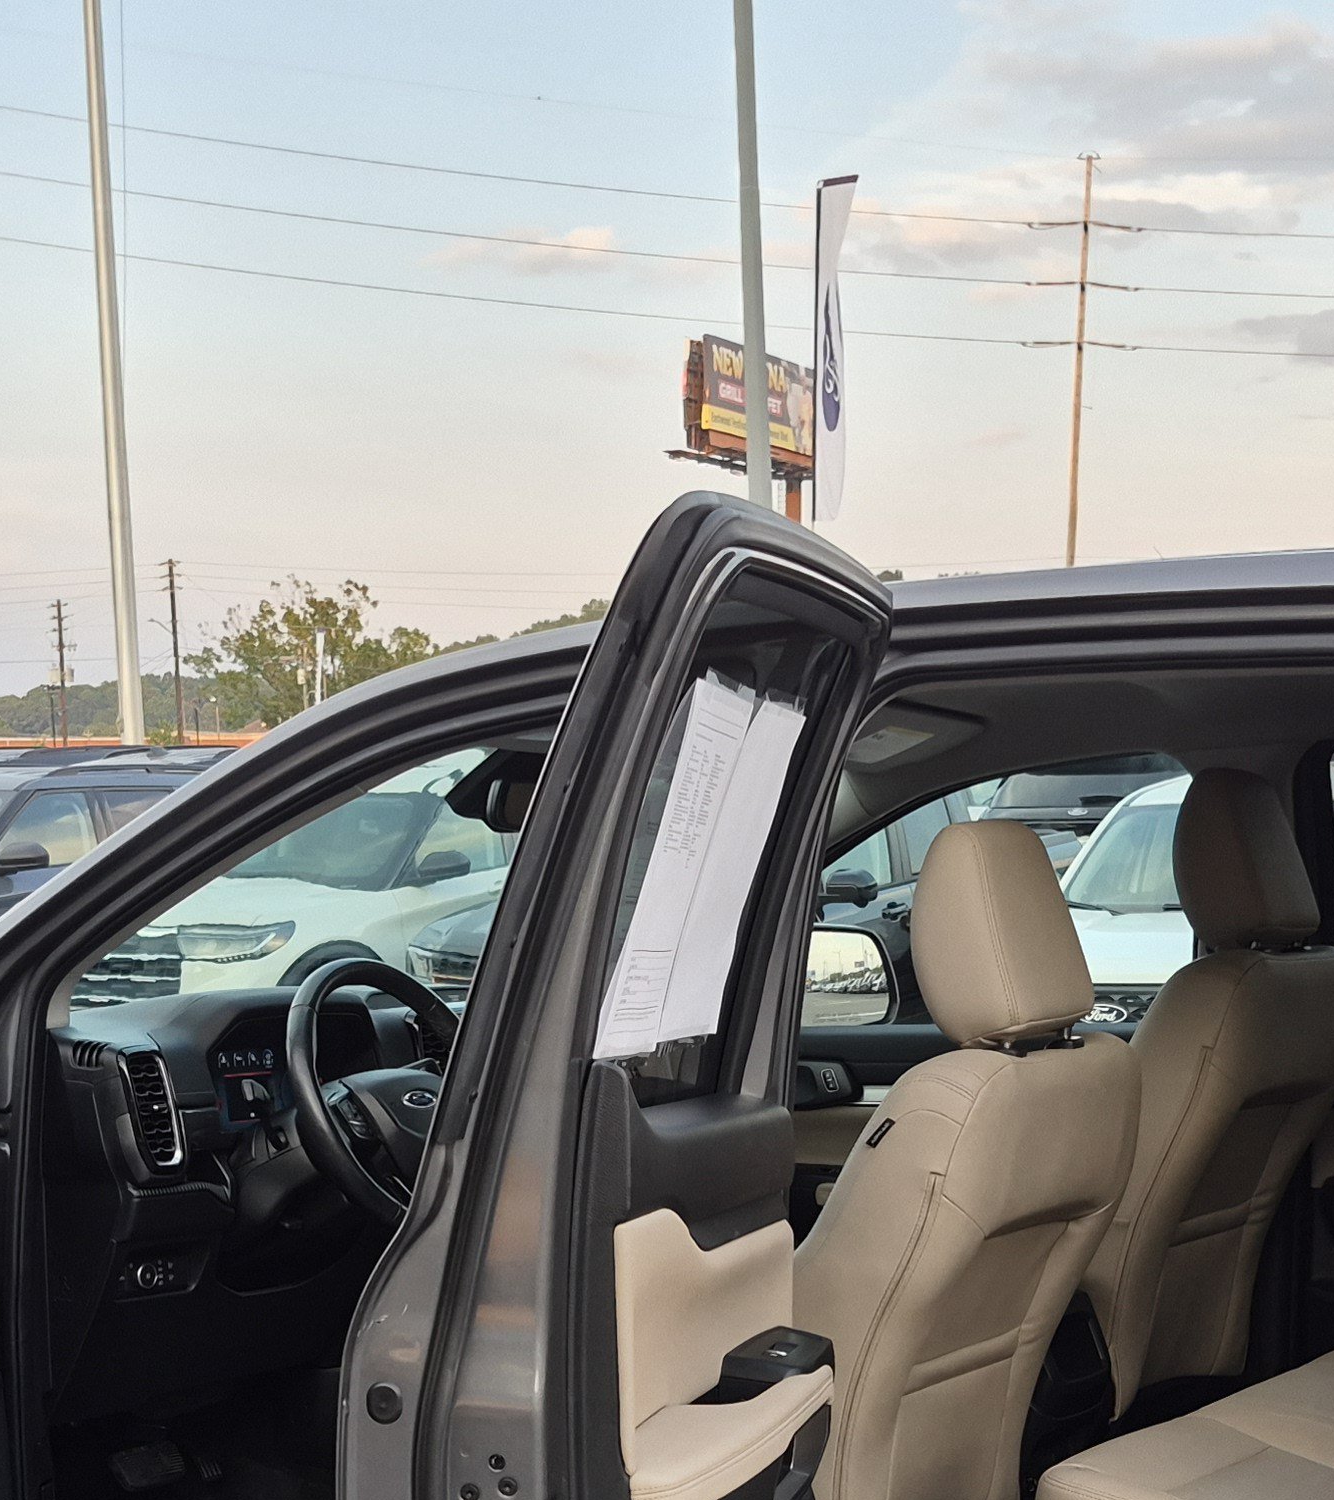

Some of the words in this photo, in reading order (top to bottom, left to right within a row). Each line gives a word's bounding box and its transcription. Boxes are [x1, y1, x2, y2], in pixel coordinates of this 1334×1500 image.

[712, 344, 744, 380] NEW
[766, 362, 786, 394] NA
[1085, 1006, 1117, 1022] Ford
